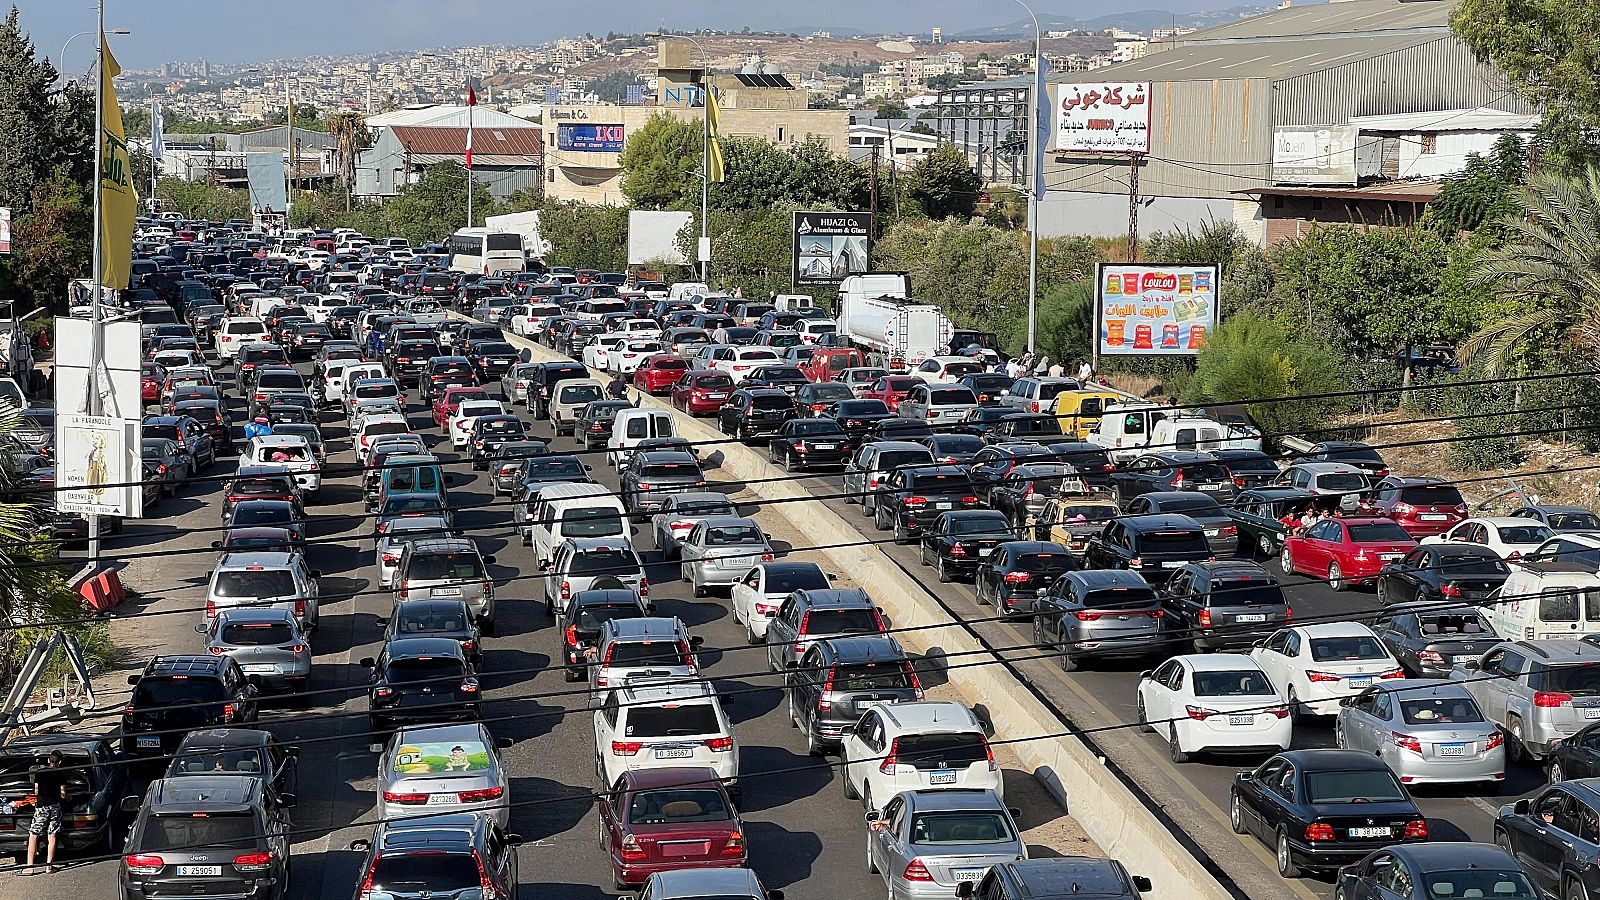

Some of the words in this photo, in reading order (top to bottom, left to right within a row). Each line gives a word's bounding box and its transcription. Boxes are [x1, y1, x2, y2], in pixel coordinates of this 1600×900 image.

[1062, 87, 1101, 117] جوني
[1103, 84, 1145, 110] شركة
[847, 218, 859, 226] Co.
[1144, 278, 1174, 288] LOULOU
[1105, 303, 1137, 318] الليرات
[1140, 304, 1169, 318] ملايين
[68, 475, 85, 483] WOMEN
[68, 493, 95, 501] BABYWEAR
[182, 865, 187, 874] S
